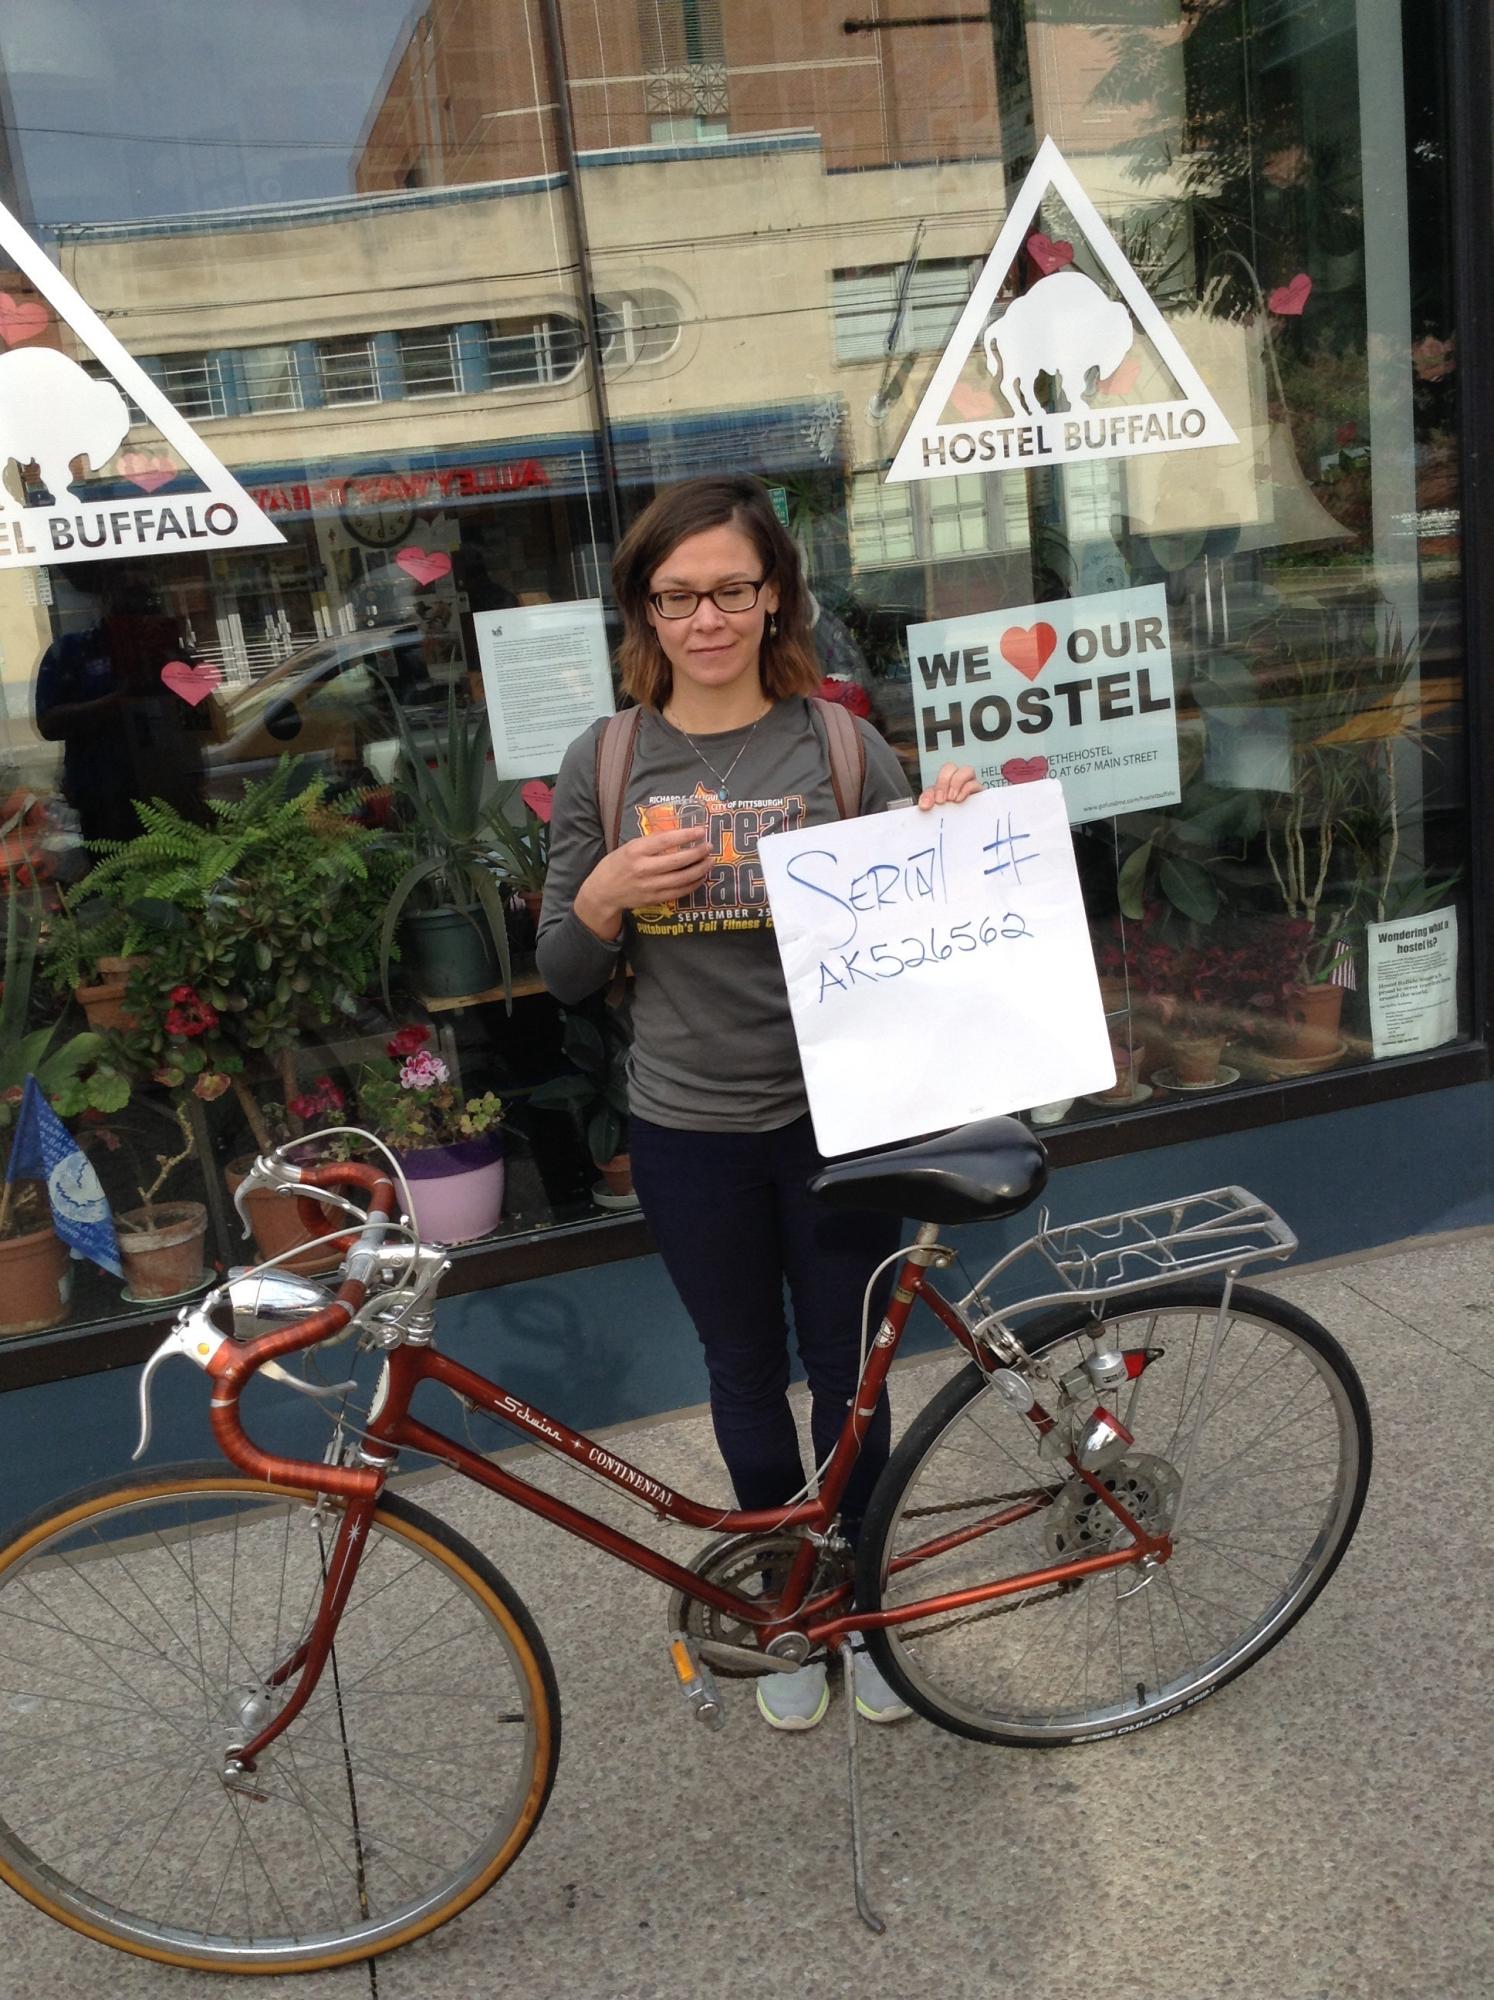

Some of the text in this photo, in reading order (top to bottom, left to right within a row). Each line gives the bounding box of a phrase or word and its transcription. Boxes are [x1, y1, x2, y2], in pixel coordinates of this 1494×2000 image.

[921, 408, 1206, 467] HOSTEL BUFFALO
[48, 502, 239, 551] BUFFALO
[917, 616, 1166, 690] WE OUR
[921, 668, 1171, 753] HOSTEL
[980, 764, 1003, 778] HEL
[1059, 763, 1073, 777] AT
[1074, 762, 1092, 775] 667
[1094, 758, 1121, 772] MAIN
[1122, 750, 1158, 766] STREET
[727, 801, 737, 810] OF
[738, 798, 784, 809] PITTSBURGH
[637, 921, 694, 936] Pittsburgh's
[699, 921, 717, 932] Fall
[722, 918, 760, 930] Fitness
[677, 909, 750, 922] SEPTEMBER
[1378, 926, 1428, 944] Wondering
[1428, 920, 1445, 934] what
[818, 912, 1034, 1003] AK526562
[1396, 937, 1438, 954] hostel is?
[494, 1396, 563, 1442] Schwinn
[588, 1447, 673, 1508] CONTINENTAL
